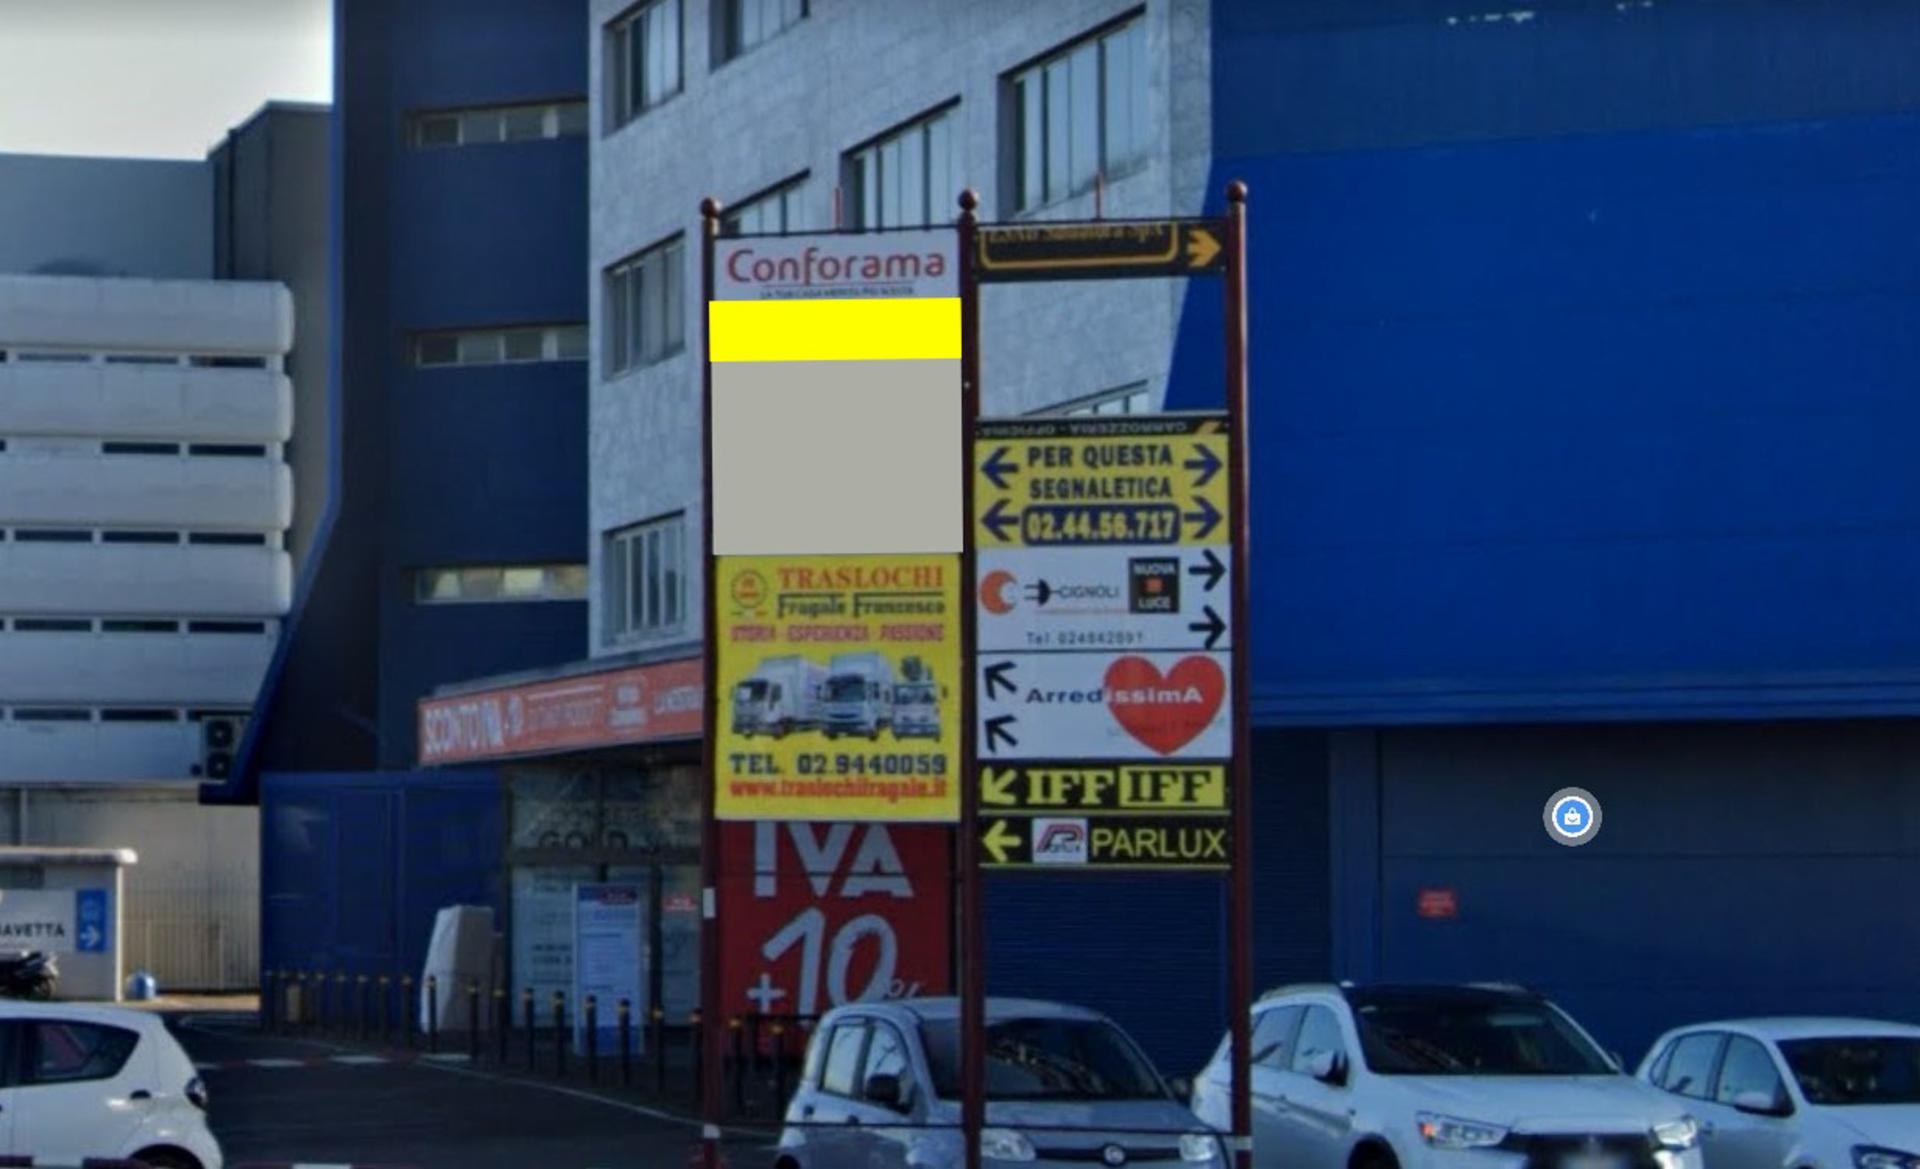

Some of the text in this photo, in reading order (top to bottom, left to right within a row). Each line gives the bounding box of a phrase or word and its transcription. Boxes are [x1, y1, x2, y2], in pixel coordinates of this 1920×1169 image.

[727, 247, 946, 285] Conforama
[1069, 421, 1187, 434] CARROZZERIA
[1027, 444, 1173, 468] PER QUESTA
[1029, 476, 1173, 499] SEGNALETICA
[1026, 511, 1177, 540] 02.44.56.717
[778, 566, 943, 590] TRASLOCHI
[1133, 563, 1176, 575] NUOVA
[1058, 583, 1119, 598] CIGNOLI
[777, 591, 945, 619] Fragale Francesco
[1138, 599, 1172, 609] LUCE
[1026, 687, 1204, 704] ArredissimA
[1025, 769, 1213, 806] IFF IFF
[1091, 828, 1226, 858] PARLUX
[754, 821, 914, 898] IVA
[0, 923, 65, 938] AVETTA
